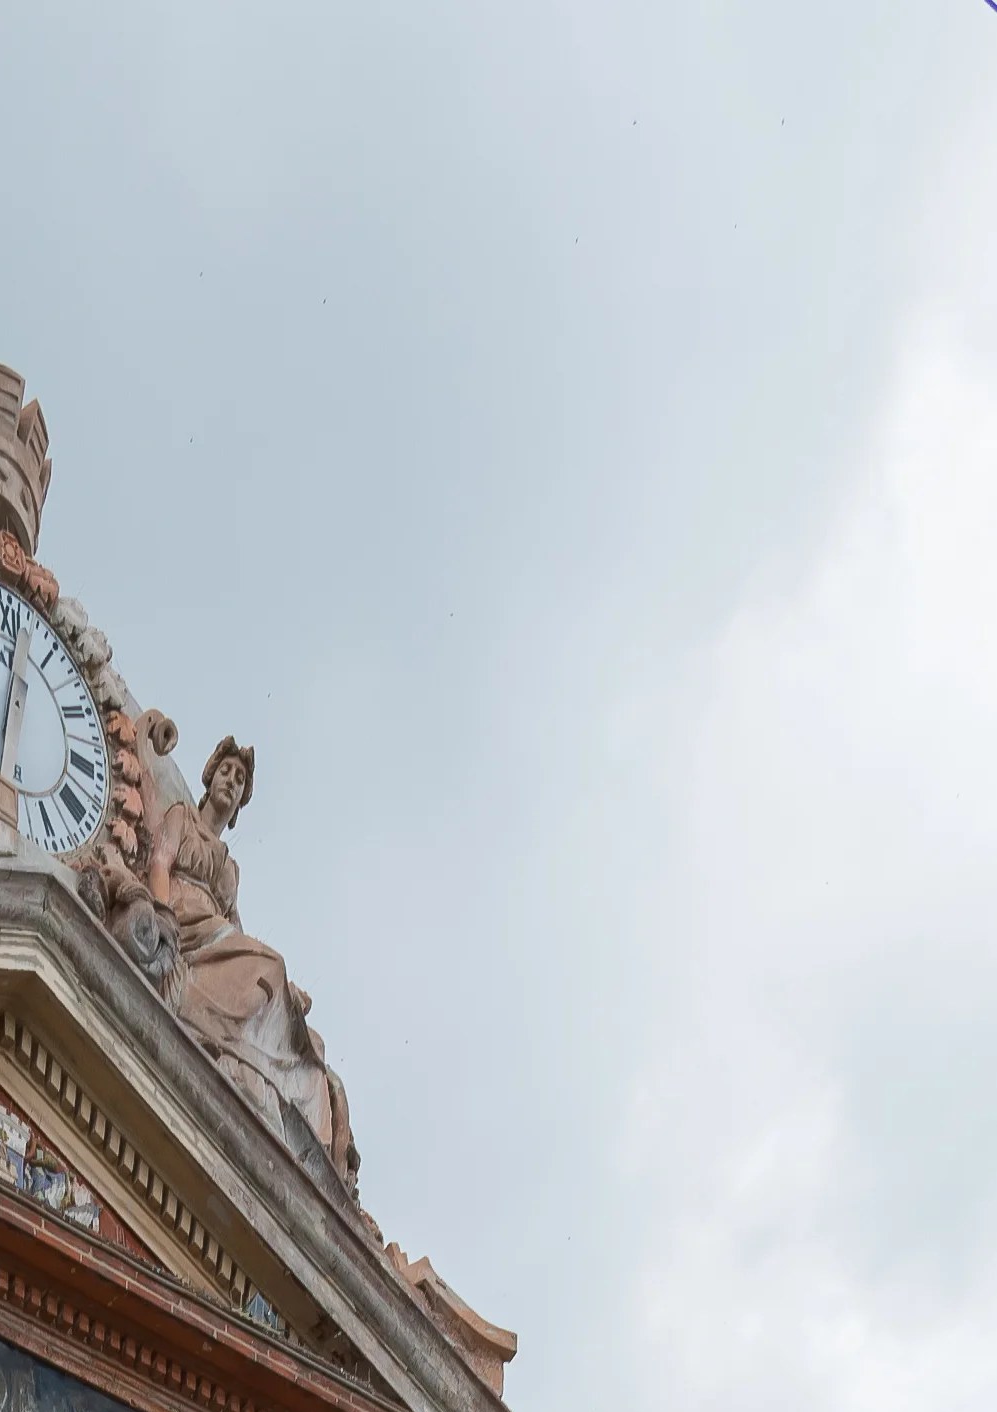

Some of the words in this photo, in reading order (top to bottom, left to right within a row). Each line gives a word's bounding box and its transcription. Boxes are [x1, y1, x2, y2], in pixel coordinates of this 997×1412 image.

[62, 705, 85, 719] II
[70, 749, 95, 780] III
[38, 800, 55, 837] V
